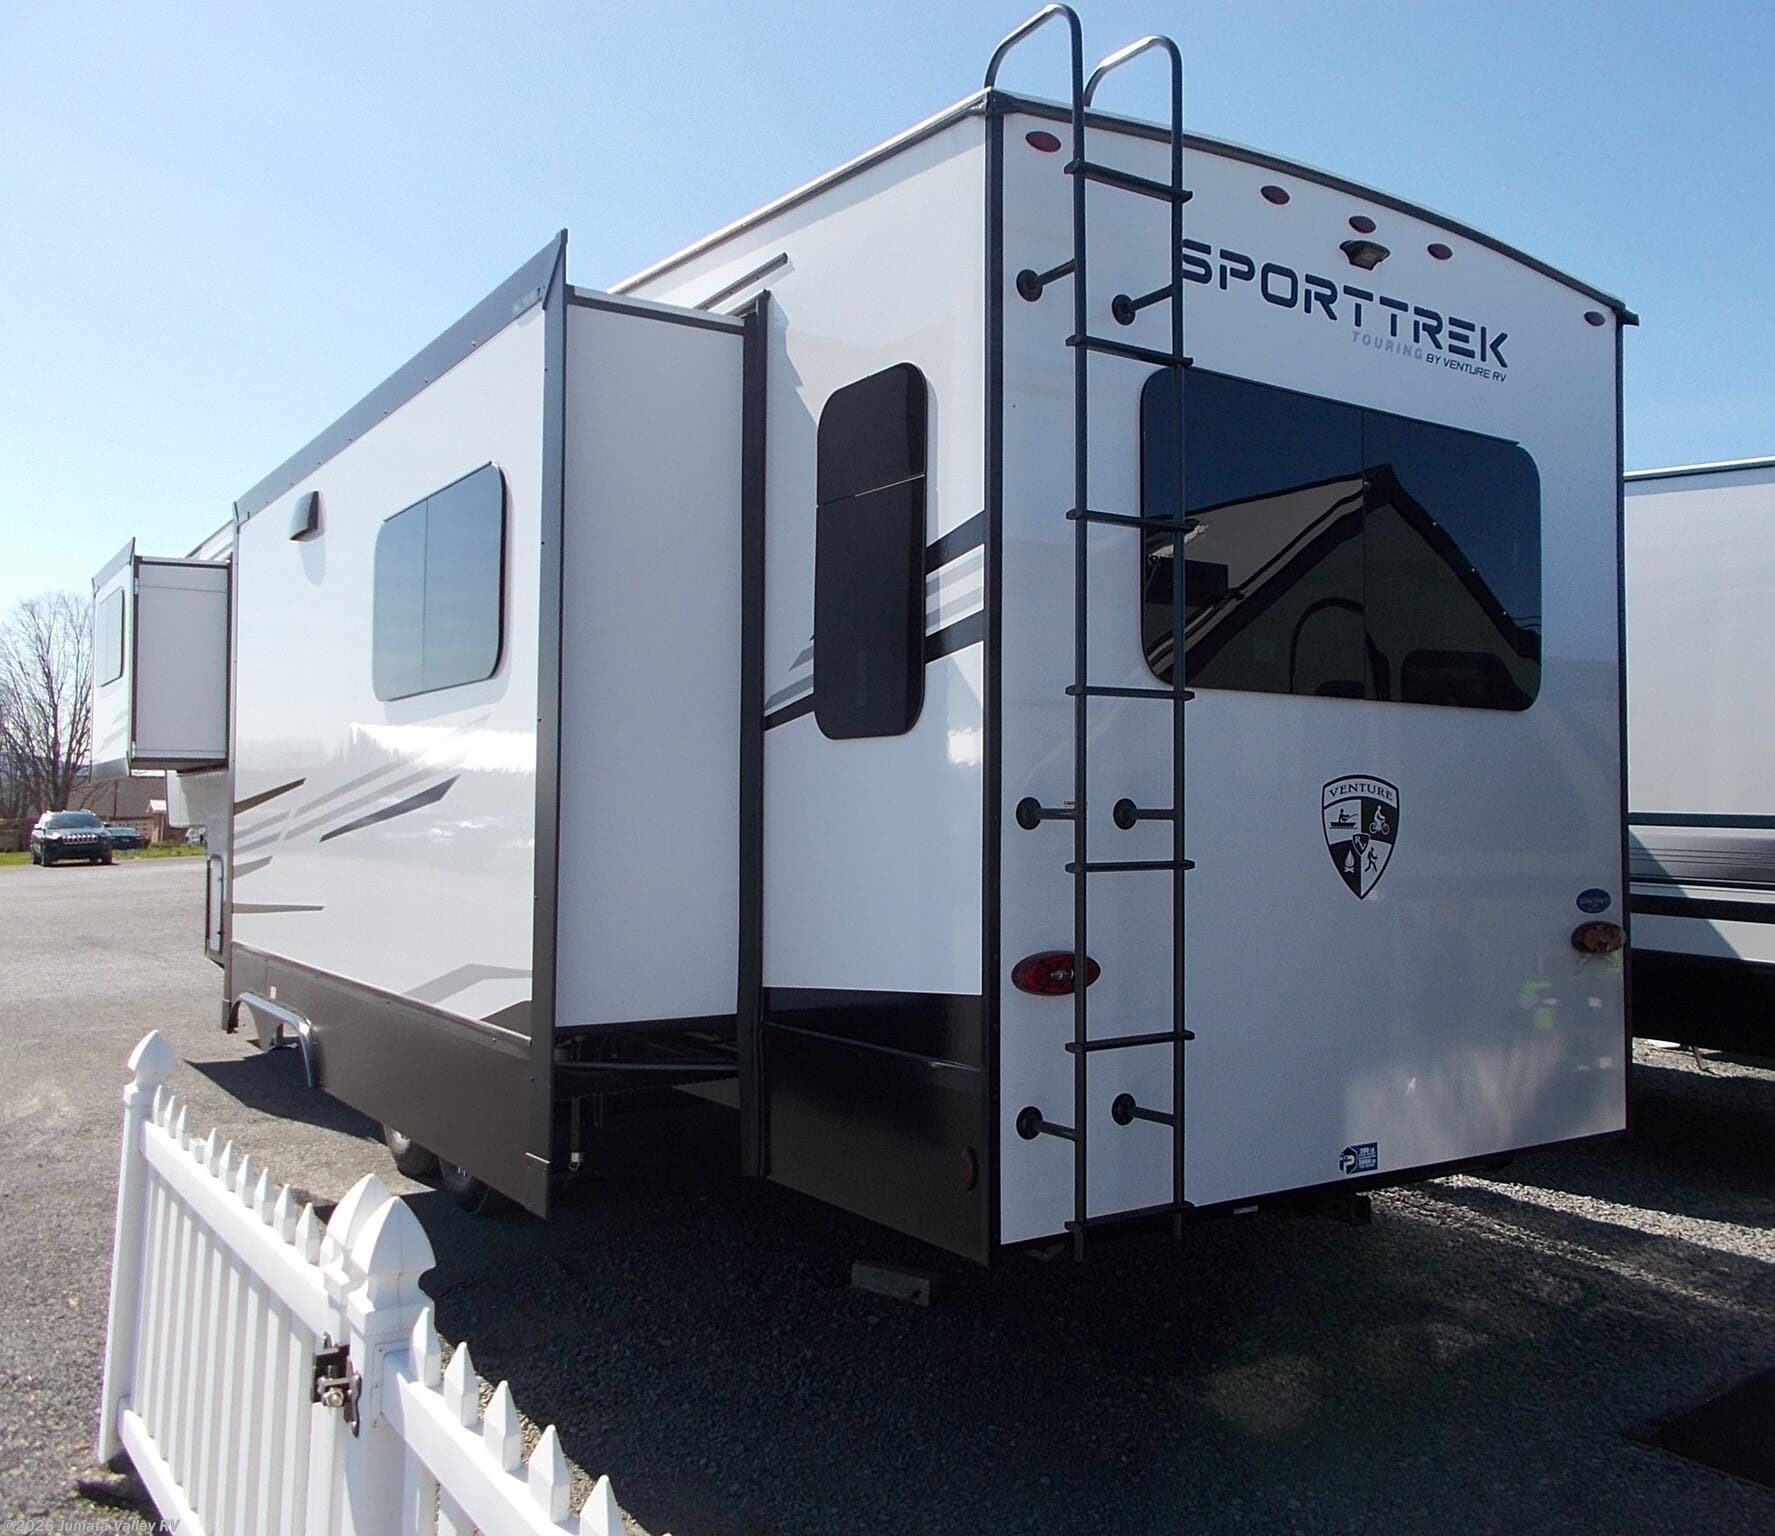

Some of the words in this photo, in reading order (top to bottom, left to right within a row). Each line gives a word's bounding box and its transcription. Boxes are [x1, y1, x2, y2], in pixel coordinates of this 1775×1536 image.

[1182, 239, 1508, 368] SPORTTREK
[1352, 331, 1423, 360] TOURING
[1426, 353, 1441, 364] BY
[1443, 358, 1491, 379] VENTURE
[1492, 371, 1507, 383] RV
[1329, 783, 1393, 800] VENTURE
